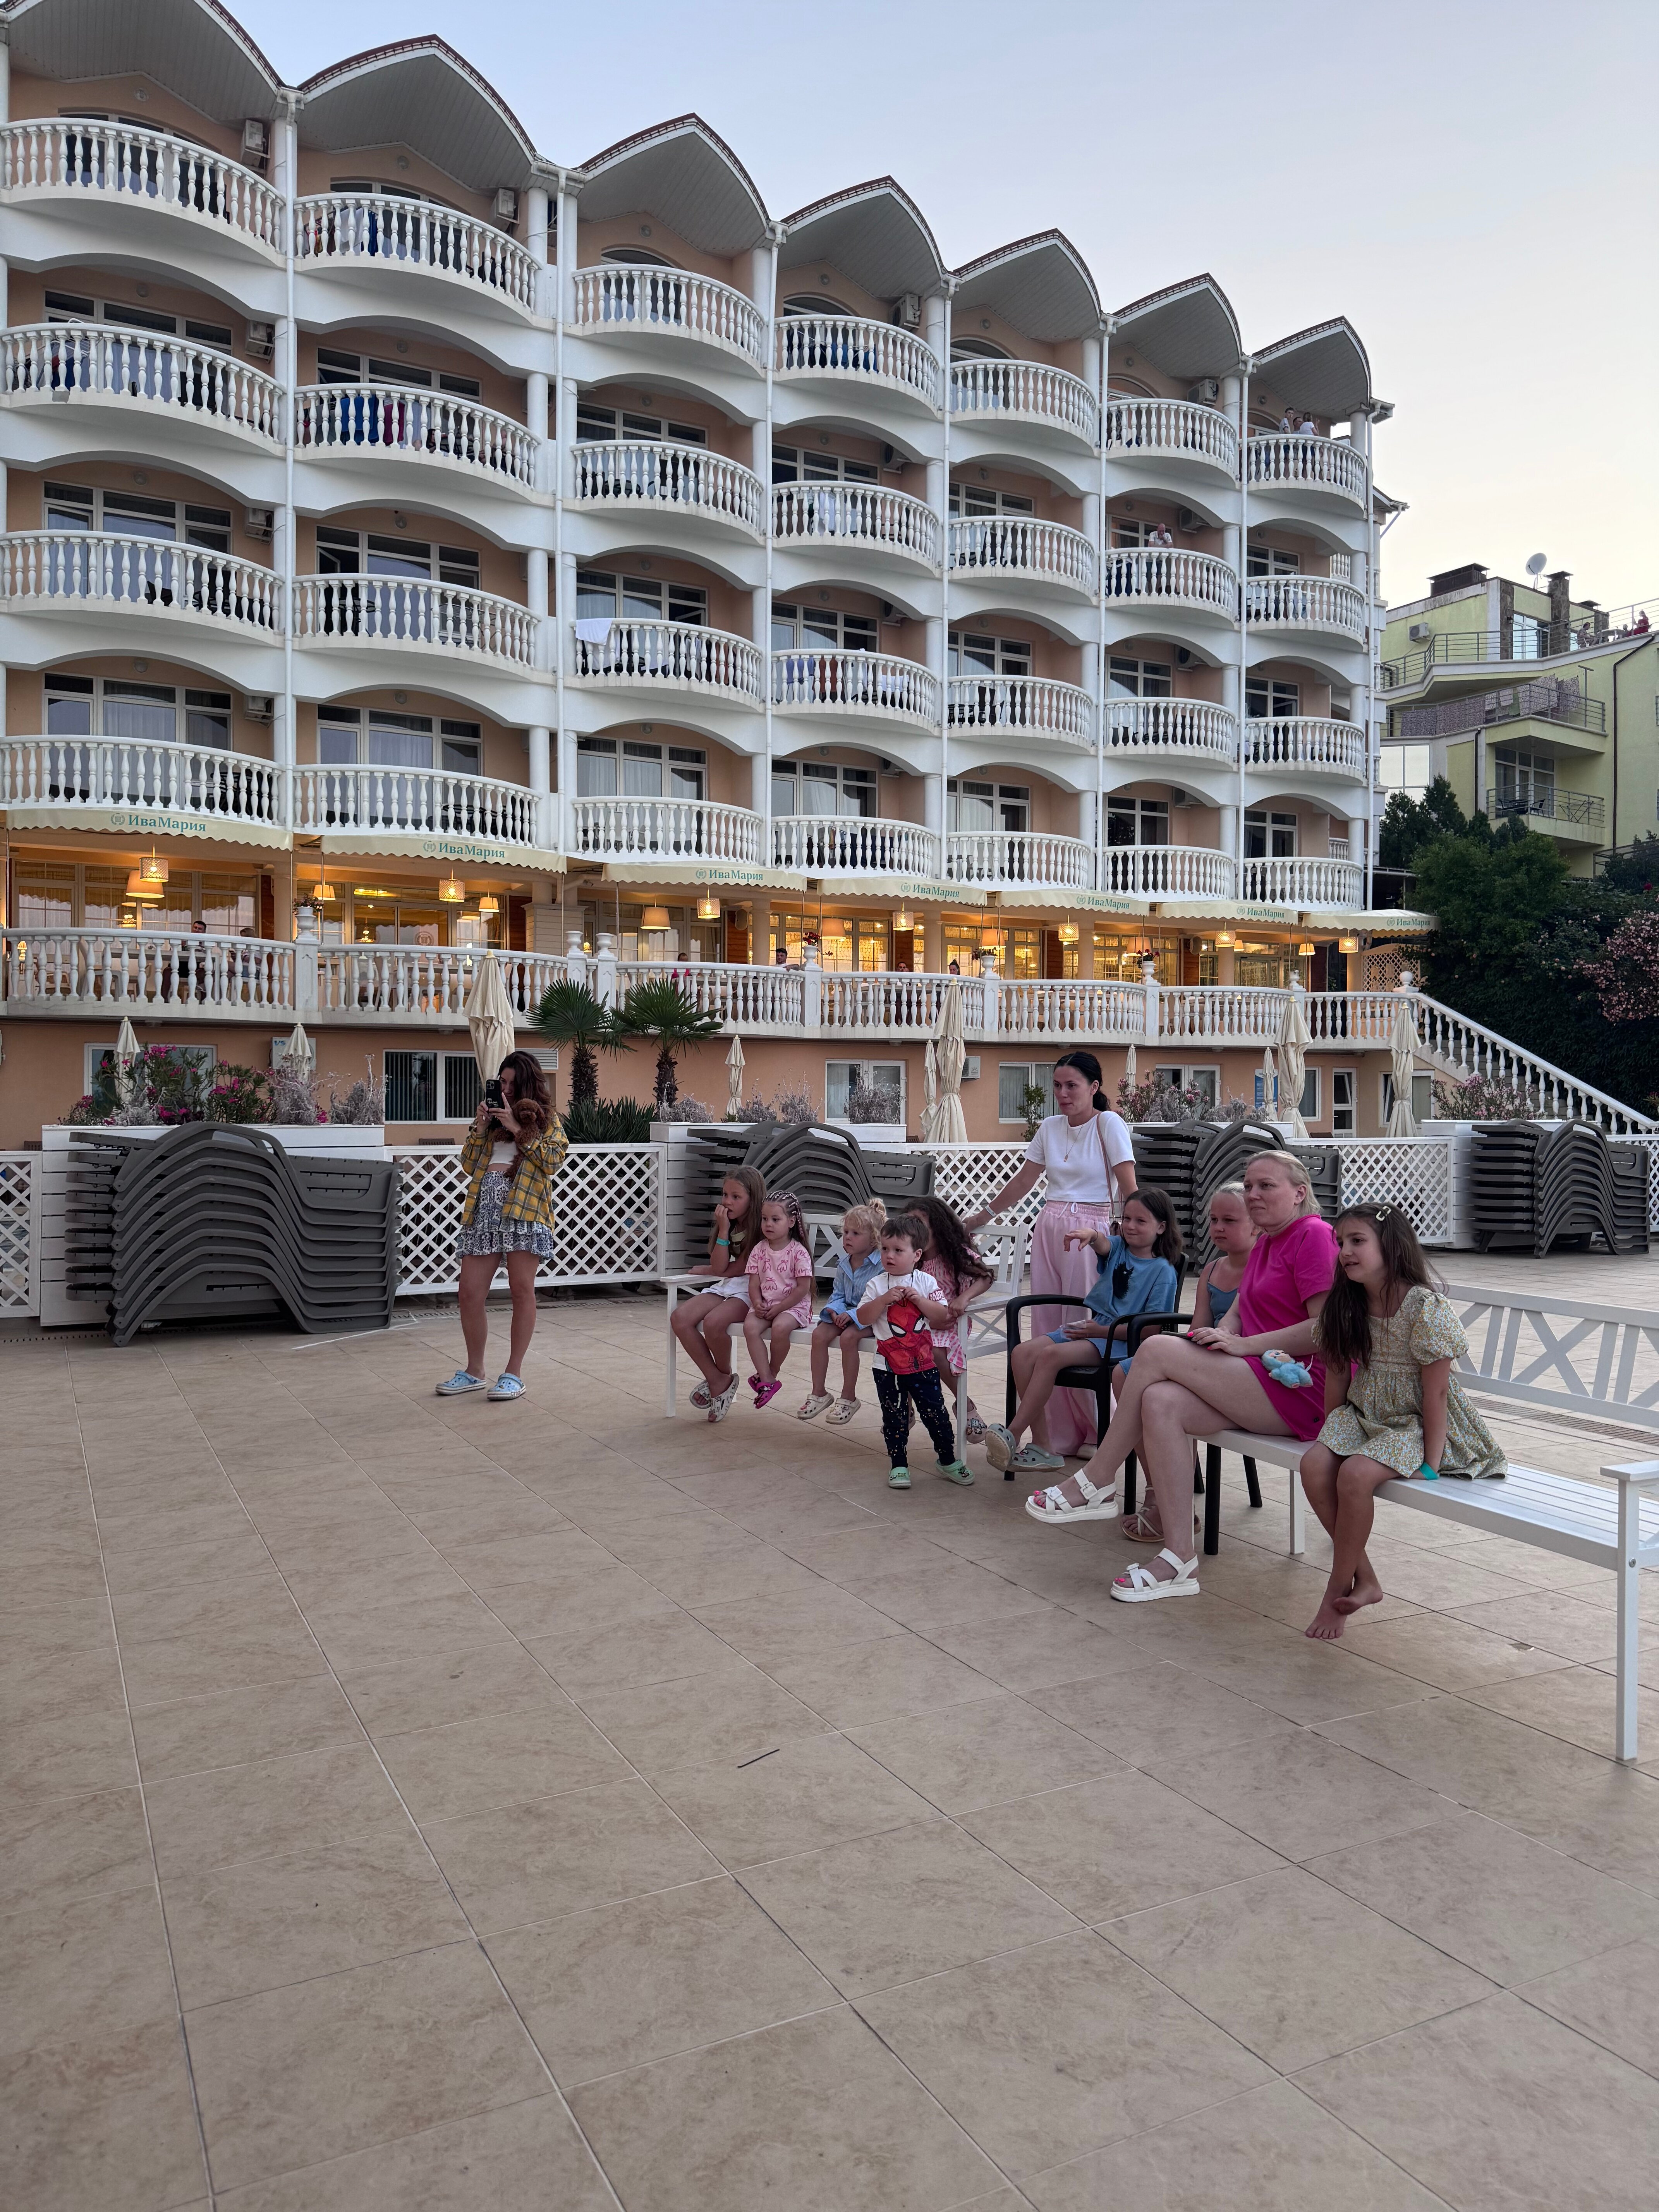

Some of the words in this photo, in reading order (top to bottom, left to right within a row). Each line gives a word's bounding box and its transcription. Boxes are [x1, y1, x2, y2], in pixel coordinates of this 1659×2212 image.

[128, 814, 206, 833] ИваМария
[438, 843, 505, 859] ИваМария
[709, 869, 763, 882] ИваМария
[912, 884, 959, 899] ИваМария
[1087, 896, 1130, 910] ИваМария
[1247, 907, 1285, 919] ИваМария
